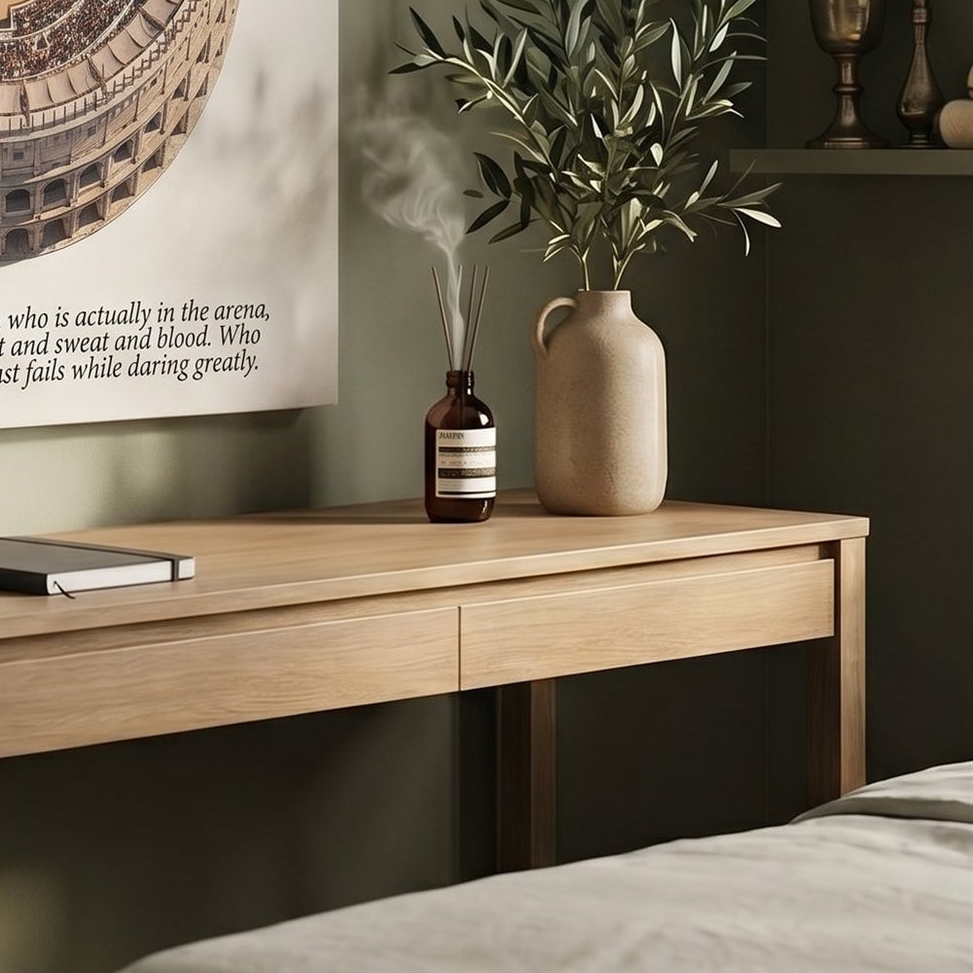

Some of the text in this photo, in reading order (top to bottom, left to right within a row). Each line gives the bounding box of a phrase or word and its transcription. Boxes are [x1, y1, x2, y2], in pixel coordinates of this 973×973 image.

[8, 305, 48, 330] who
[55, 306, 69, 328] is
[75, 301, 152, 331] actually
[156, 302, 175, 324] in
[181, 299, 209, 322] the
[214, 304, 269, 322] arena,
[11, 331, 50, 356] and
[54, 332, 110, 355] sweat
[115, 325, 153, 351] and
[157, 324, 211, 349] blood.
[220, 322, 260, 347] Who
[21, 358, 65, 390] fails
[71, 355, 122, 380] while
[128, 353, 190, 382] daring
[192, 348, 258, 382] greatly.
